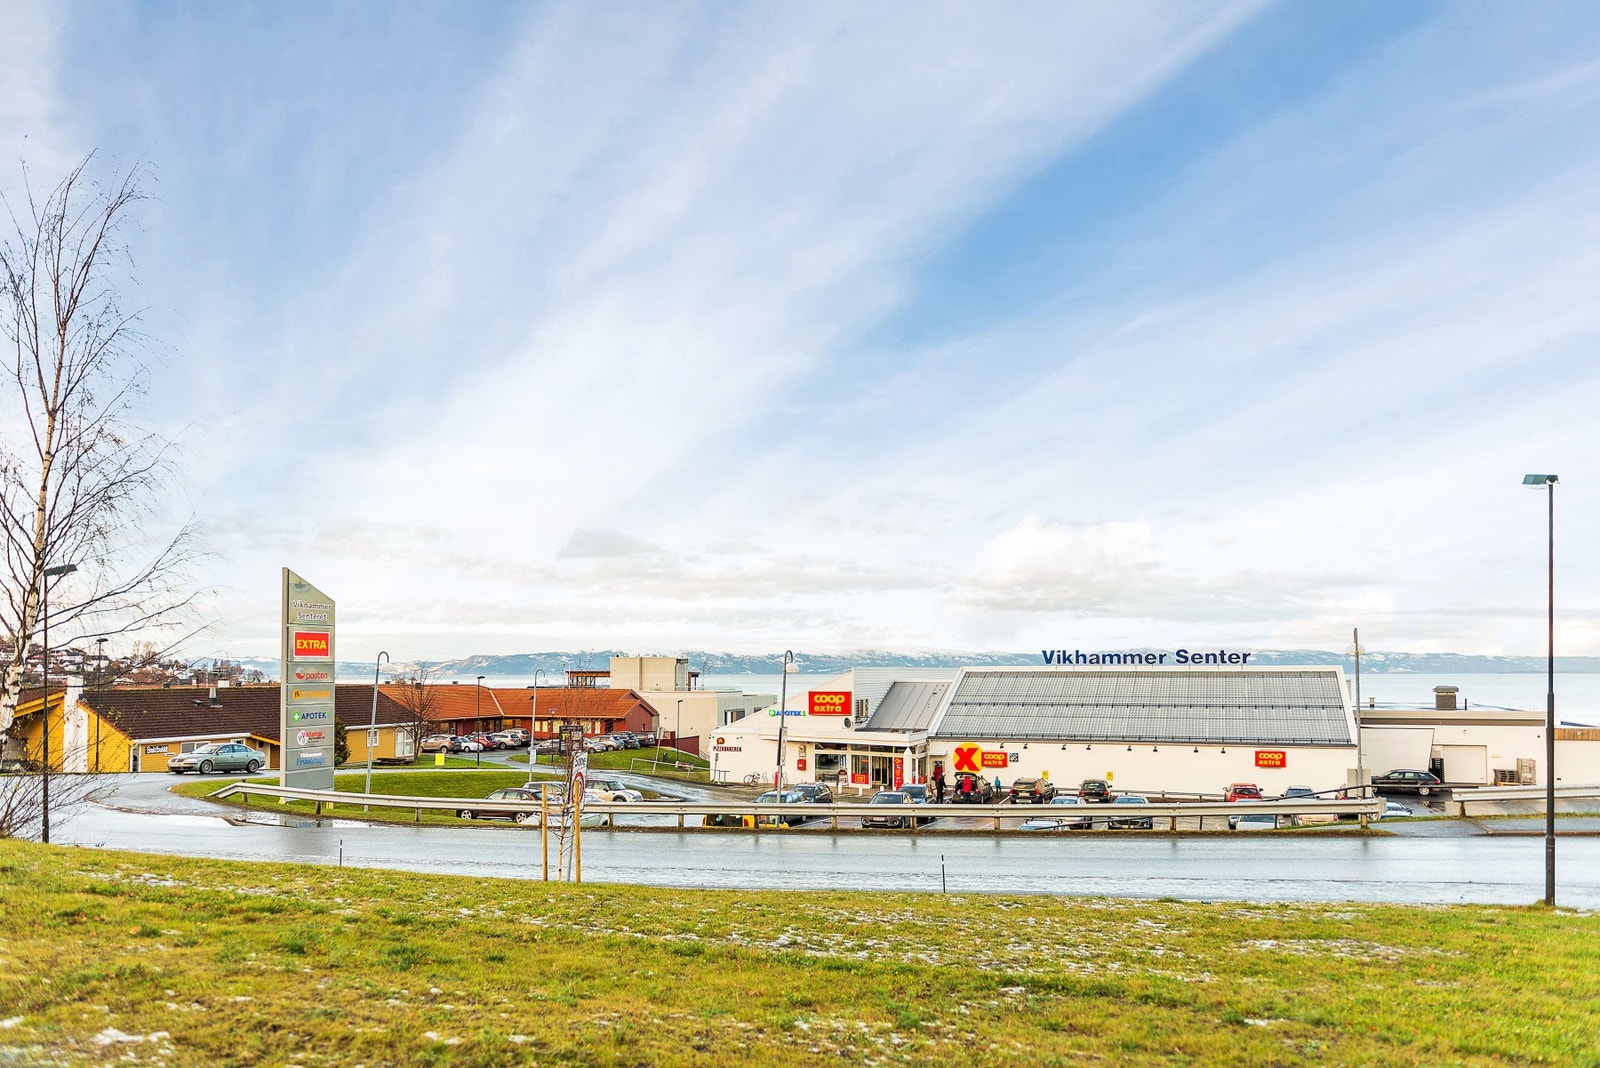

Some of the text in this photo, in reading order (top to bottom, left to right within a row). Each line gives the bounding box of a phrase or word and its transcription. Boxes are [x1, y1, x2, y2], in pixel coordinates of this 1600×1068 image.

[293, 600, 331, 610] Vikhammer
[298, 612, 327, 621] Senteret
[297, 639, 327, 649] EXTRA
[1042, 648, 1251, 665] Vikhammer Senter
[305, 672, 327, 681] posten
[814, 694, 845, 705] coop
[814, 704, 842, 712] extra
[301, 712, 326, 720] APOTEK
[984, 753, 1005, 761] coop
[1258, 752, 1283, 760] coop
[1258, 759, 1283, 767] extra
